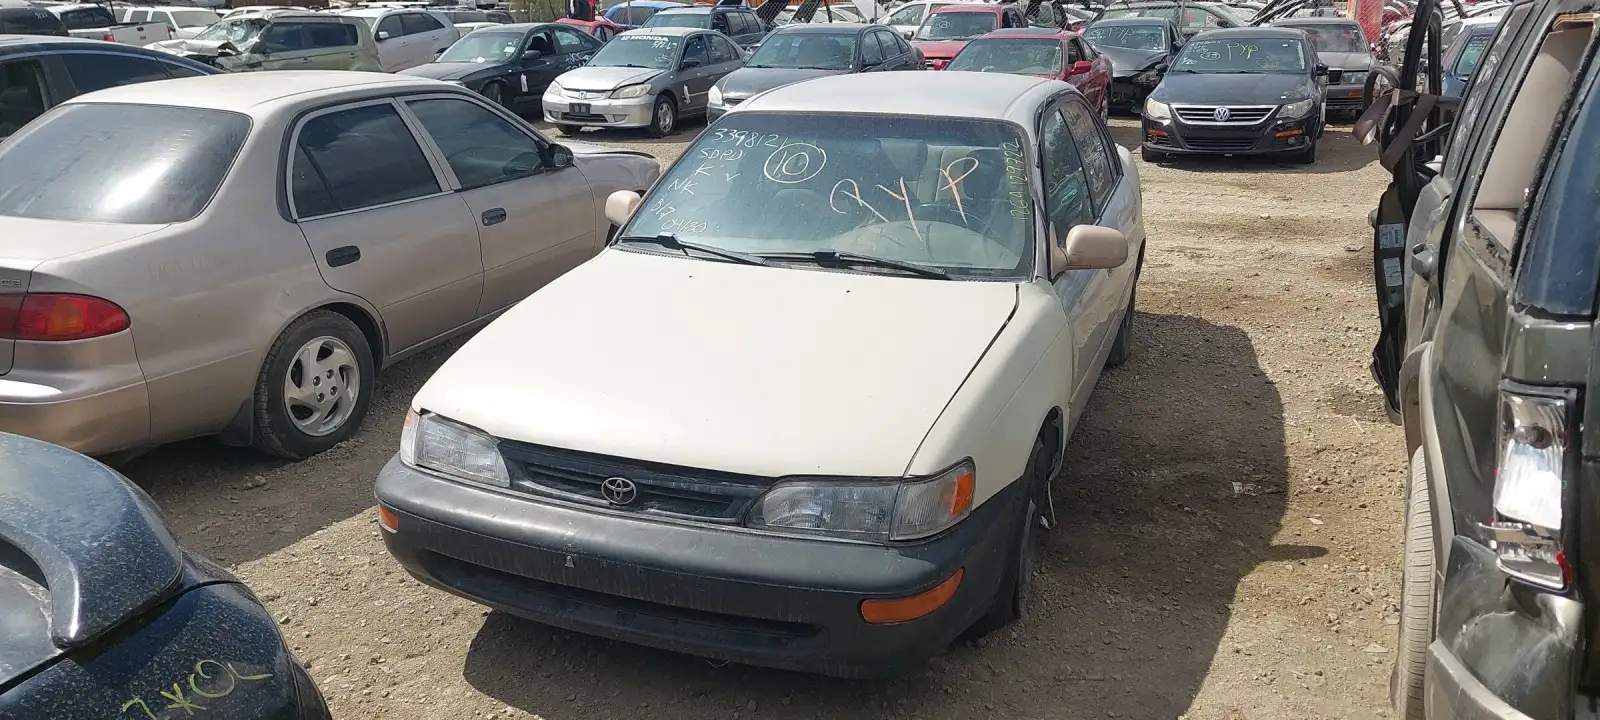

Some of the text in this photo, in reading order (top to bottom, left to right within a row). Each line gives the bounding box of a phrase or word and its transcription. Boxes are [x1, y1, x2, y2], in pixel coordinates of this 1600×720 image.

[1226, 42, 1259, 60] PYP
[772, 150, 810, 176] 10
[668, 177, 699, 196] NK
